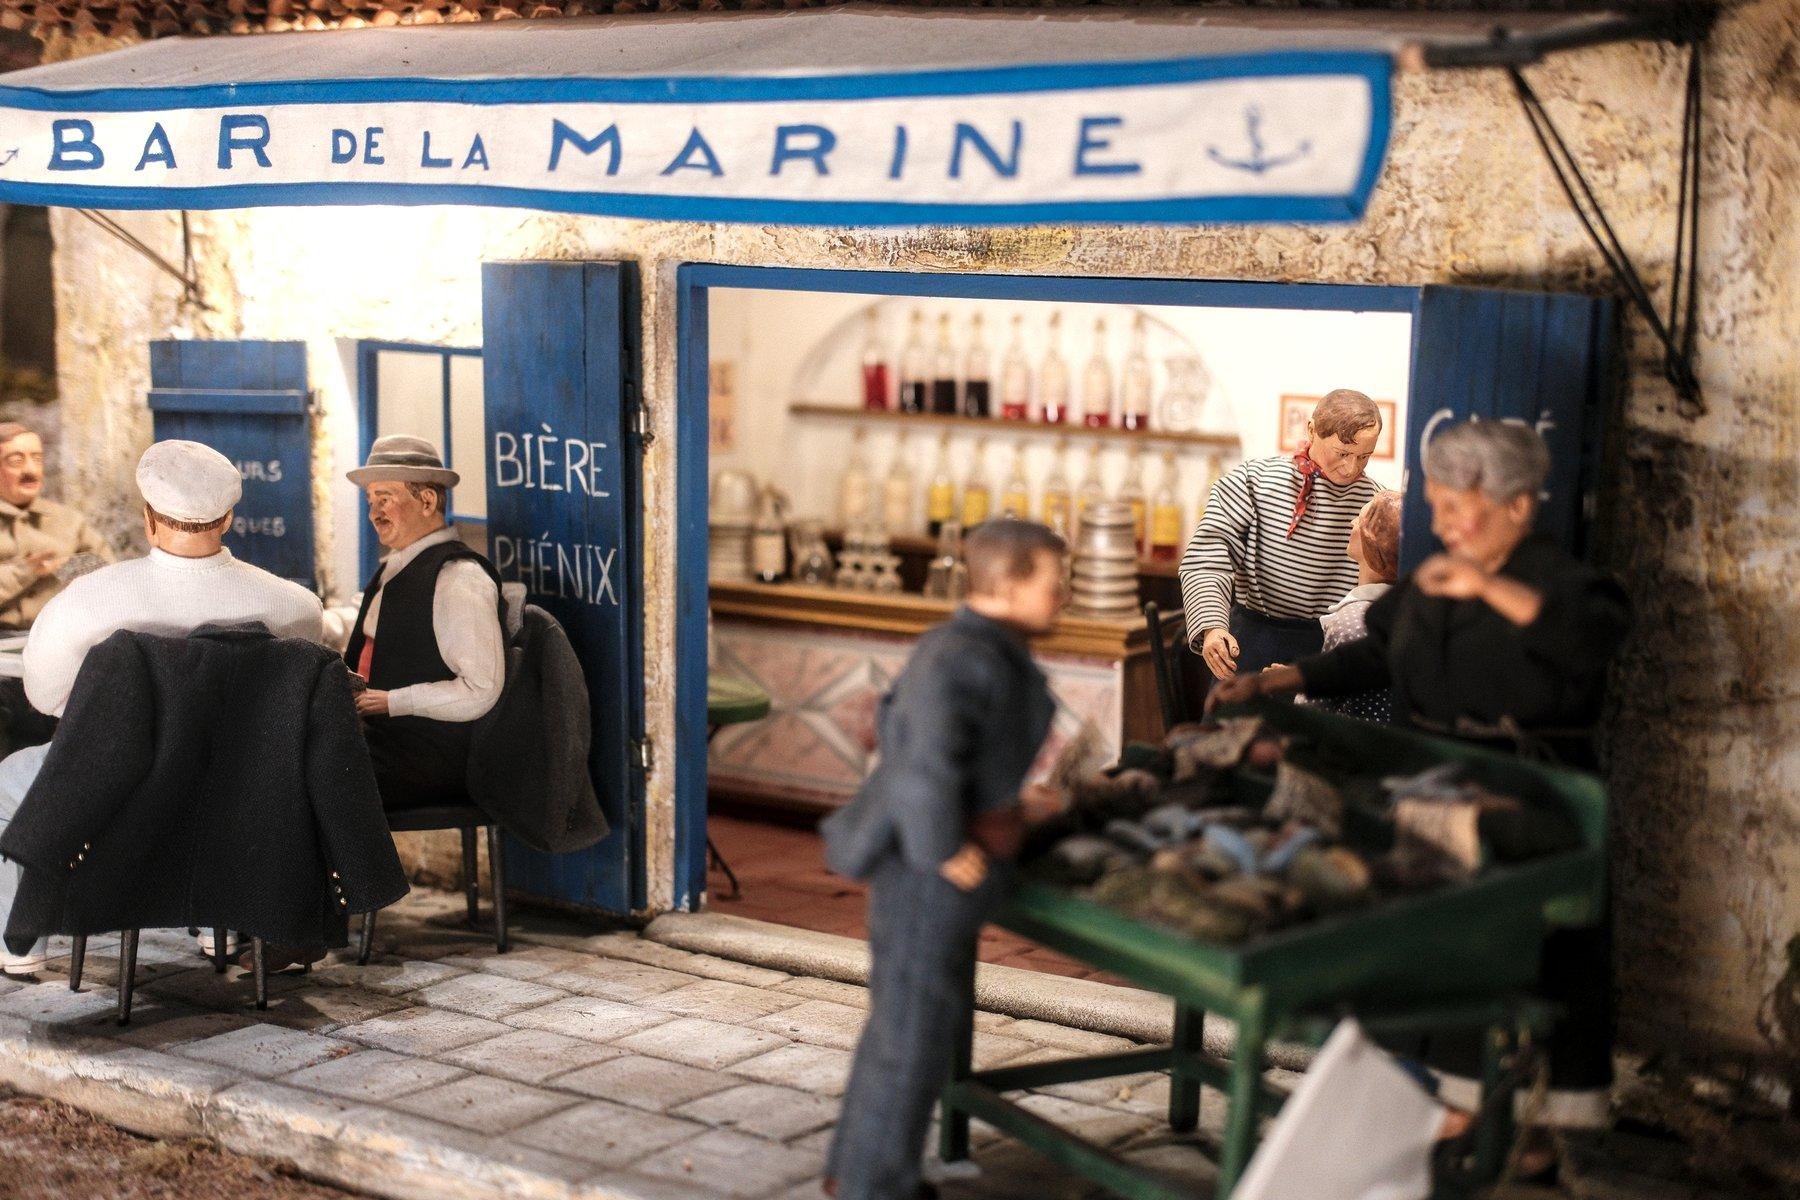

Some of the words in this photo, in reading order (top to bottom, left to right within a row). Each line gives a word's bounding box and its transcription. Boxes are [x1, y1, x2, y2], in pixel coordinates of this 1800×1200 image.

[48, 114, 272, 171] BAR
[331, 127, 385, 165] DE
[421, 132, 490, 171] LA
[548, 116, 1142, 177] MARINE
[236, 459, 283, 483] URS
[495, 422, 610, 497] BIÈRE
[495, 531, 618, 605] PHÉNIX
